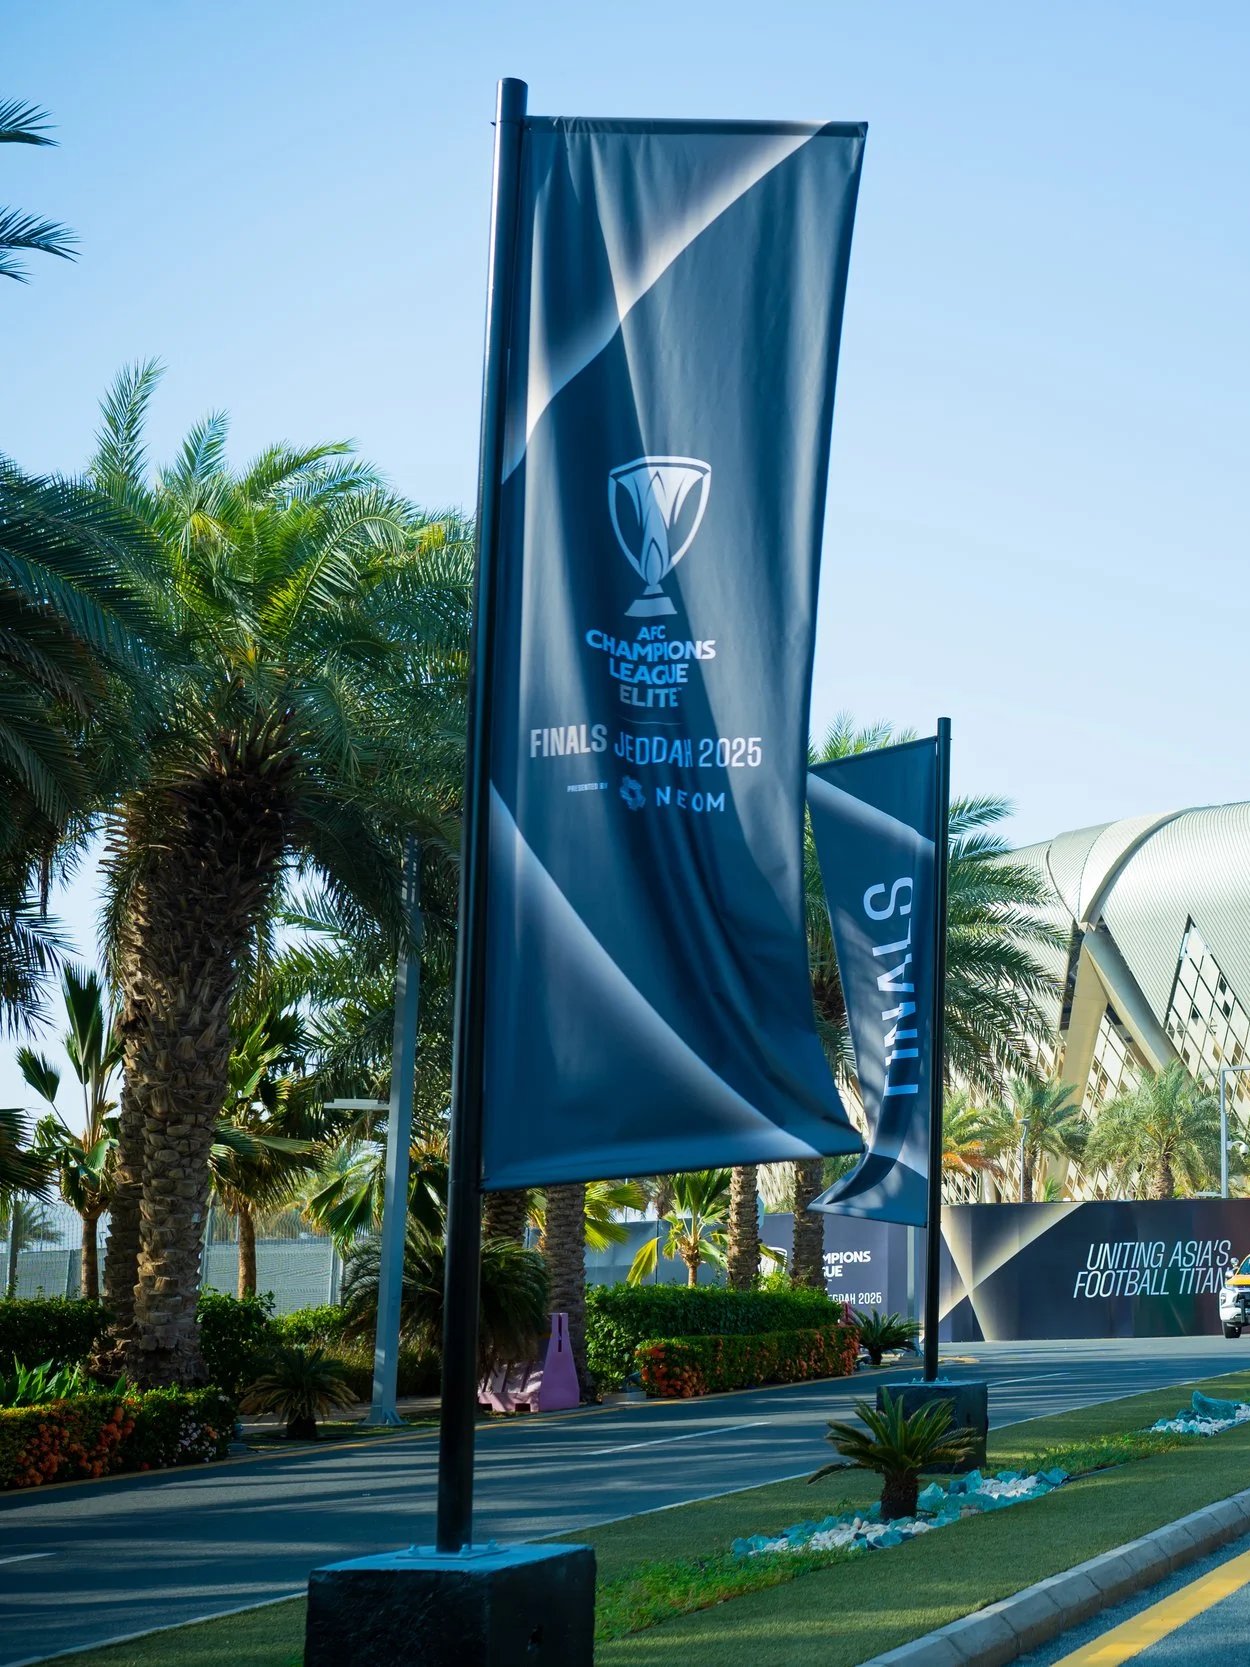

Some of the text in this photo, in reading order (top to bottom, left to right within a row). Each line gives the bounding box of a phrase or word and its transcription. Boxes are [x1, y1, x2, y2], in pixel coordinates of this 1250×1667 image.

[585, 629, 717, 662] CHAMPIONS
[636, 625, 666, 641] AFC
[609, 658, 689, 685] LEAGUE
[619, 684, 679, 708] ELITE
[530, 723, 762, 768] FINALS JEDDAH 2025
[567, 782, 608, 793] PRESENTED BY
[656, 786, 726, 812] NEOM
[863, 877, 919, 1097] FINALS
[822, 1250, 872, 1265] MPIONS
[1086, 1239, 1231, 1270] UNITING ASIA'S
[1073, 1266, 1230, 1299] FOOTBALL TITAN
[858, 1292, 882, 1305] 2025
